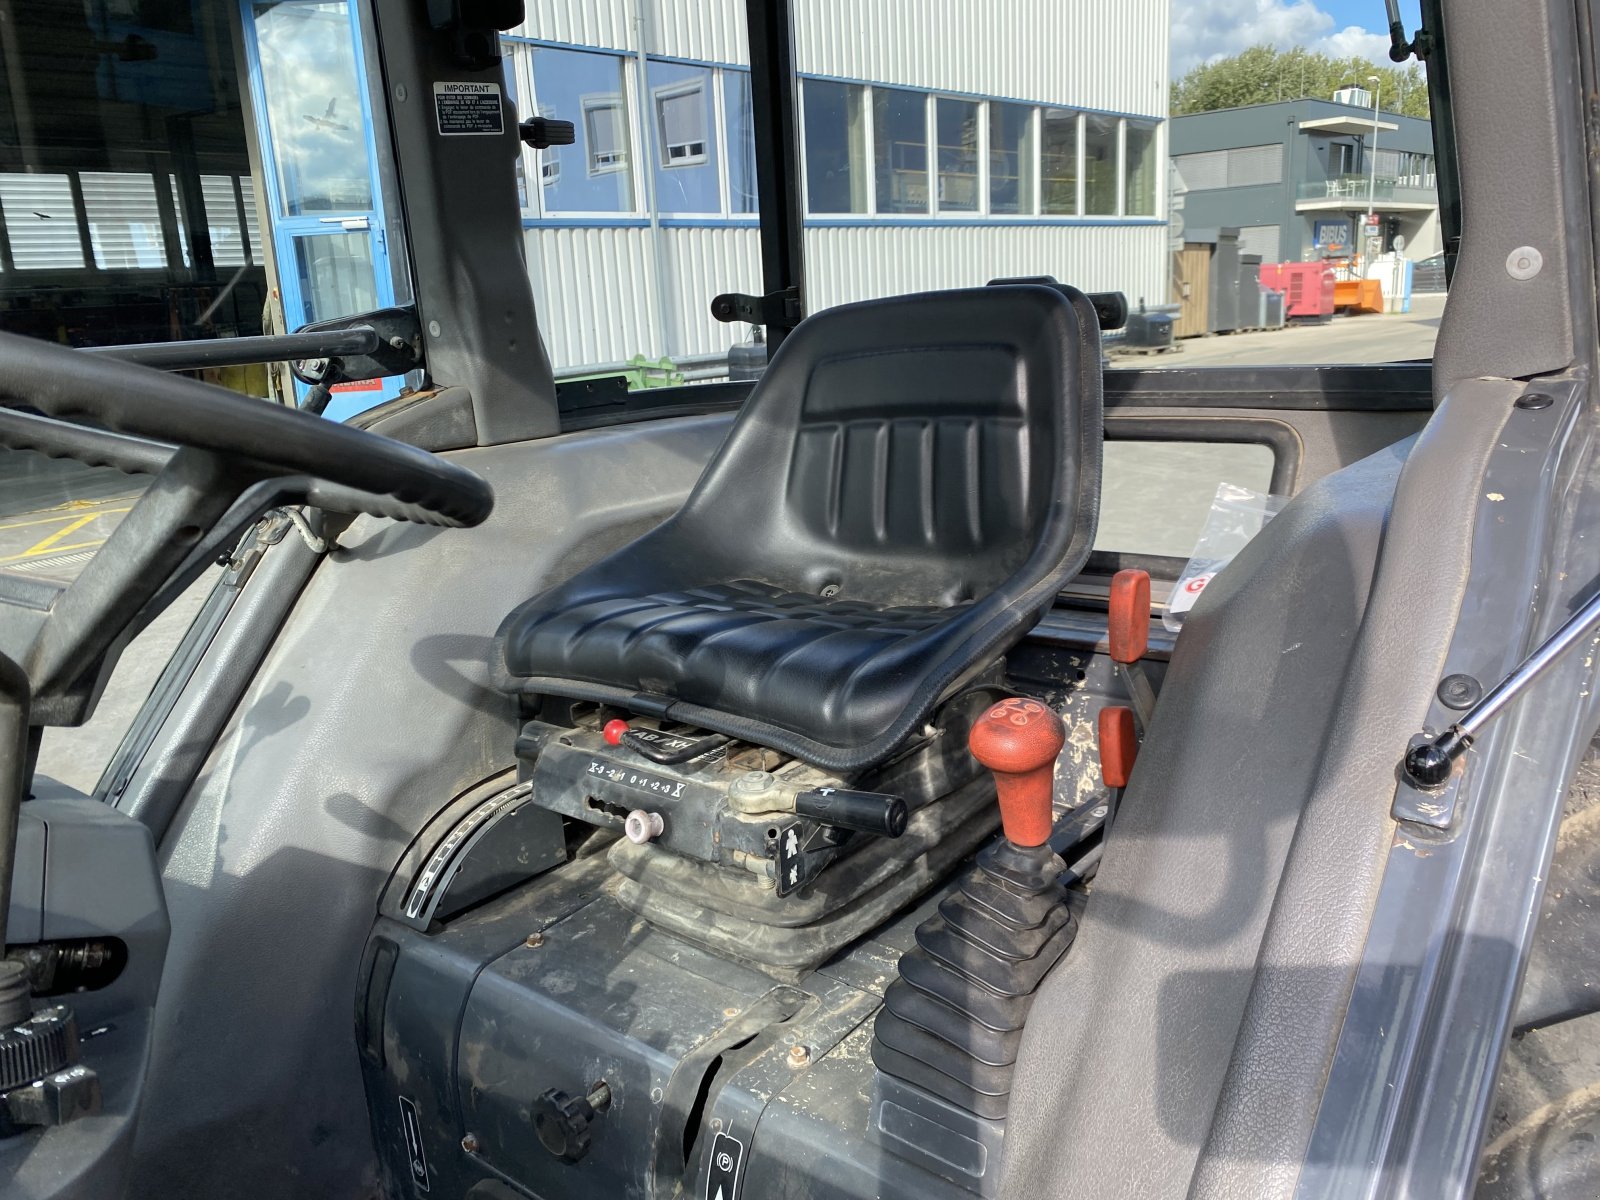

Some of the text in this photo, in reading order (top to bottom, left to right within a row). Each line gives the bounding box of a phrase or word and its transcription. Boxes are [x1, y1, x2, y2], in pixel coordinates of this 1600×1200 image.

[444, 84, 490, 93] IMPORTANT
[1319, 225, 1347, 243] BIBUS
[630, 775, 637, 784] 0
